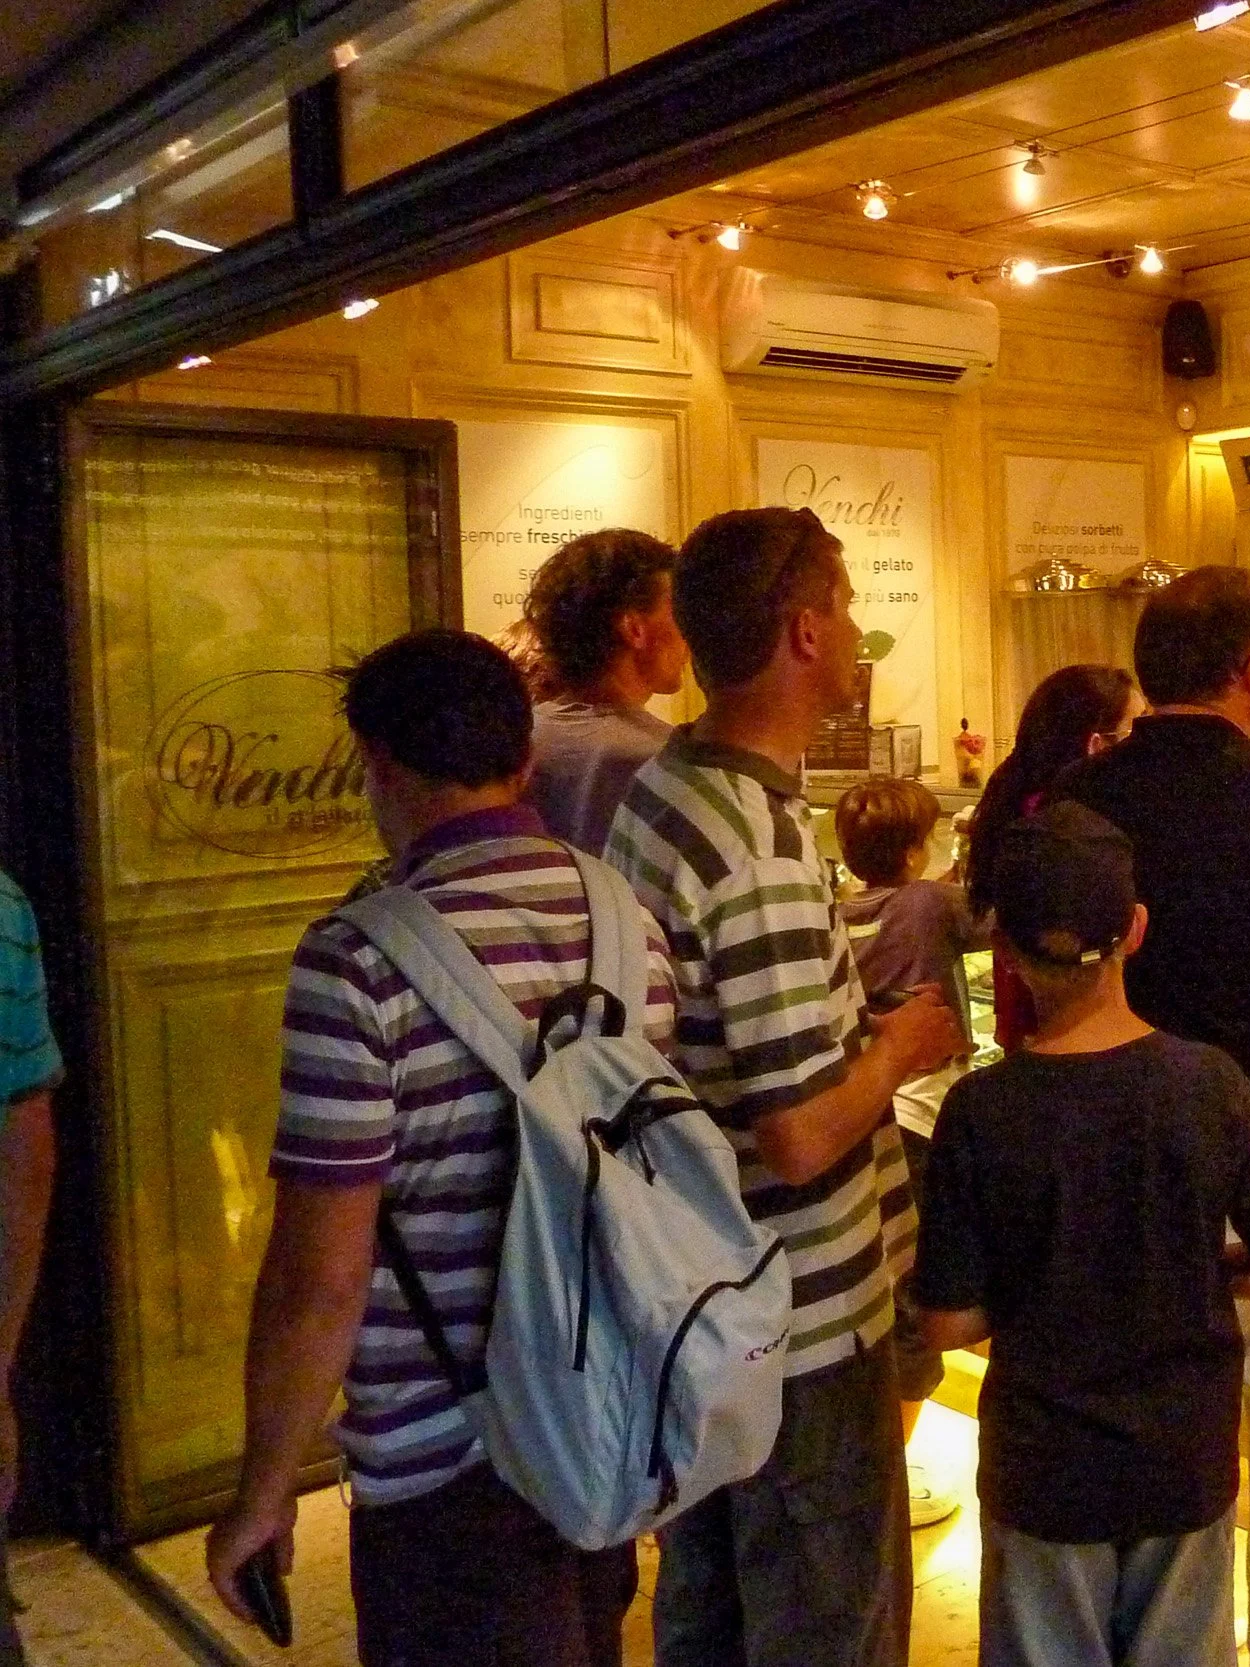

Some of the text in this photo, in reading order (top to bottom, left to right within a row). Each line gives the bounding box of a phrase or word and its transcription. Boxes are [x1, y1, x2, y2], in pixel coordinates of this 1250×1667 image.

[783, 464, 903, 527] Venchi
[518, 503, 603, 524] Ingredienti
[459, 530, 522, 547] sempre
[1081, 523, 1124, 537] sorbetti
[873, 557, 914, 575] gelato
[888, 591, 919, 603] sano
